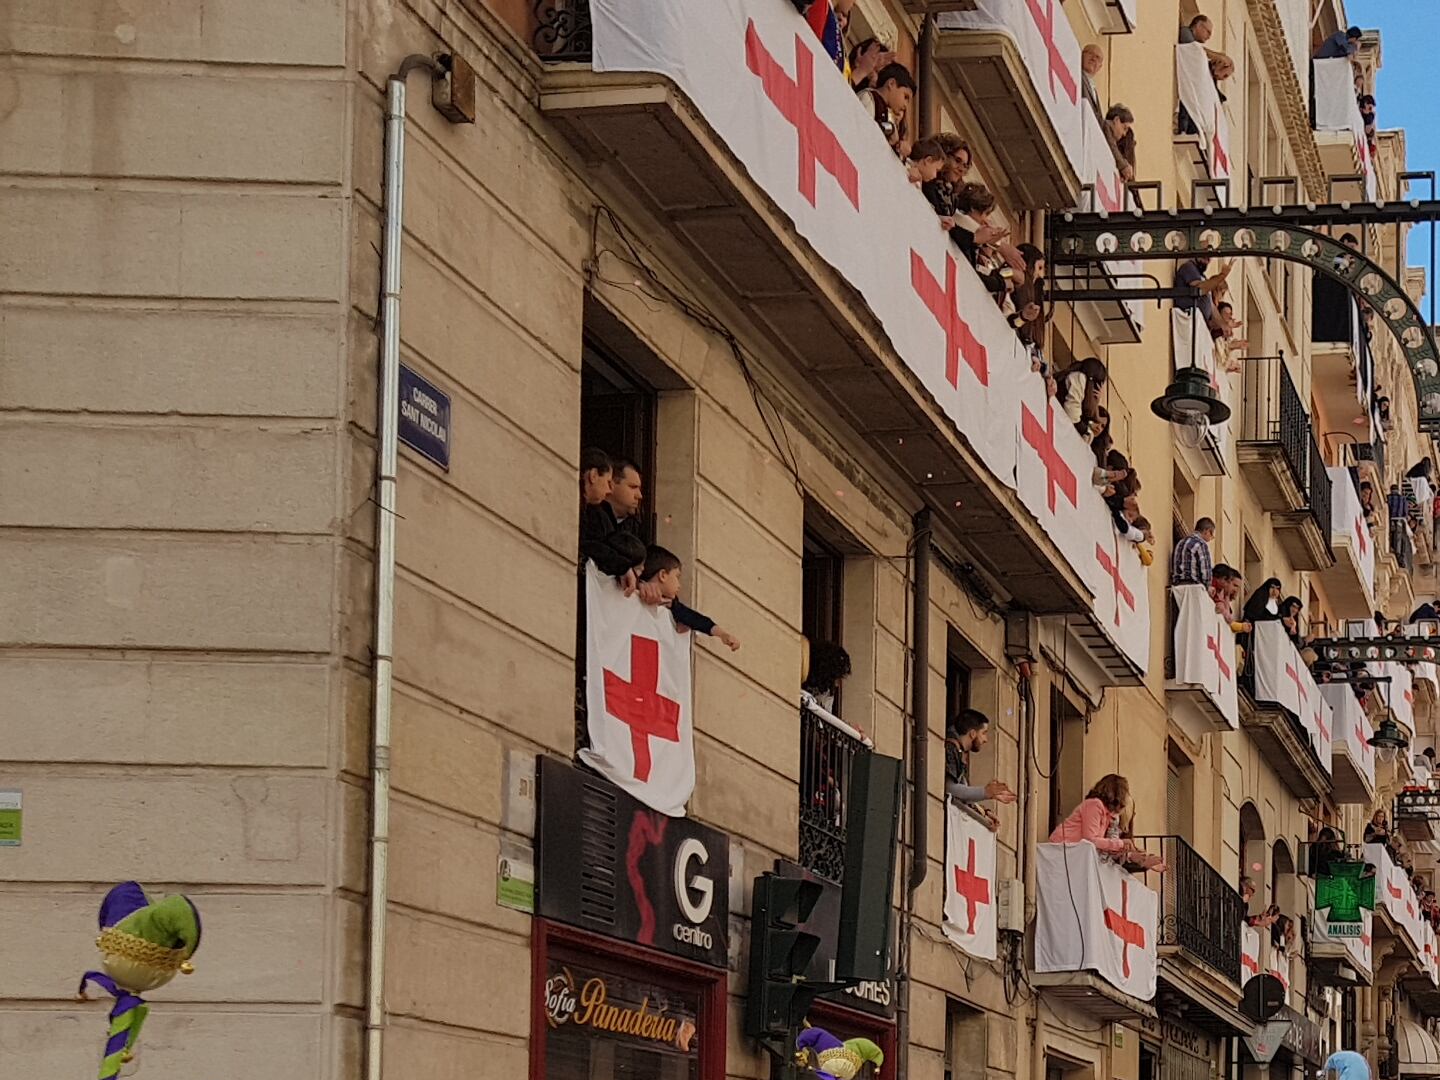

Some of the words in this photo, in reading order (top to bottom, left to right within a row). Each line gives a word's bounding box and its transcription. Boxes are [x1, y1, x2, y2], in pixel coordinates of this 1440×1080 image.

[412, 387, 438, 417] CARRER
[401, 400, 421, 425] SANT
[420, 411, 447, 442] NICOLAU
[674, 837, 714, 923] G
[672, 922, 713, 950] centro
[1327, 924, 1361, 936] ANALISIS
